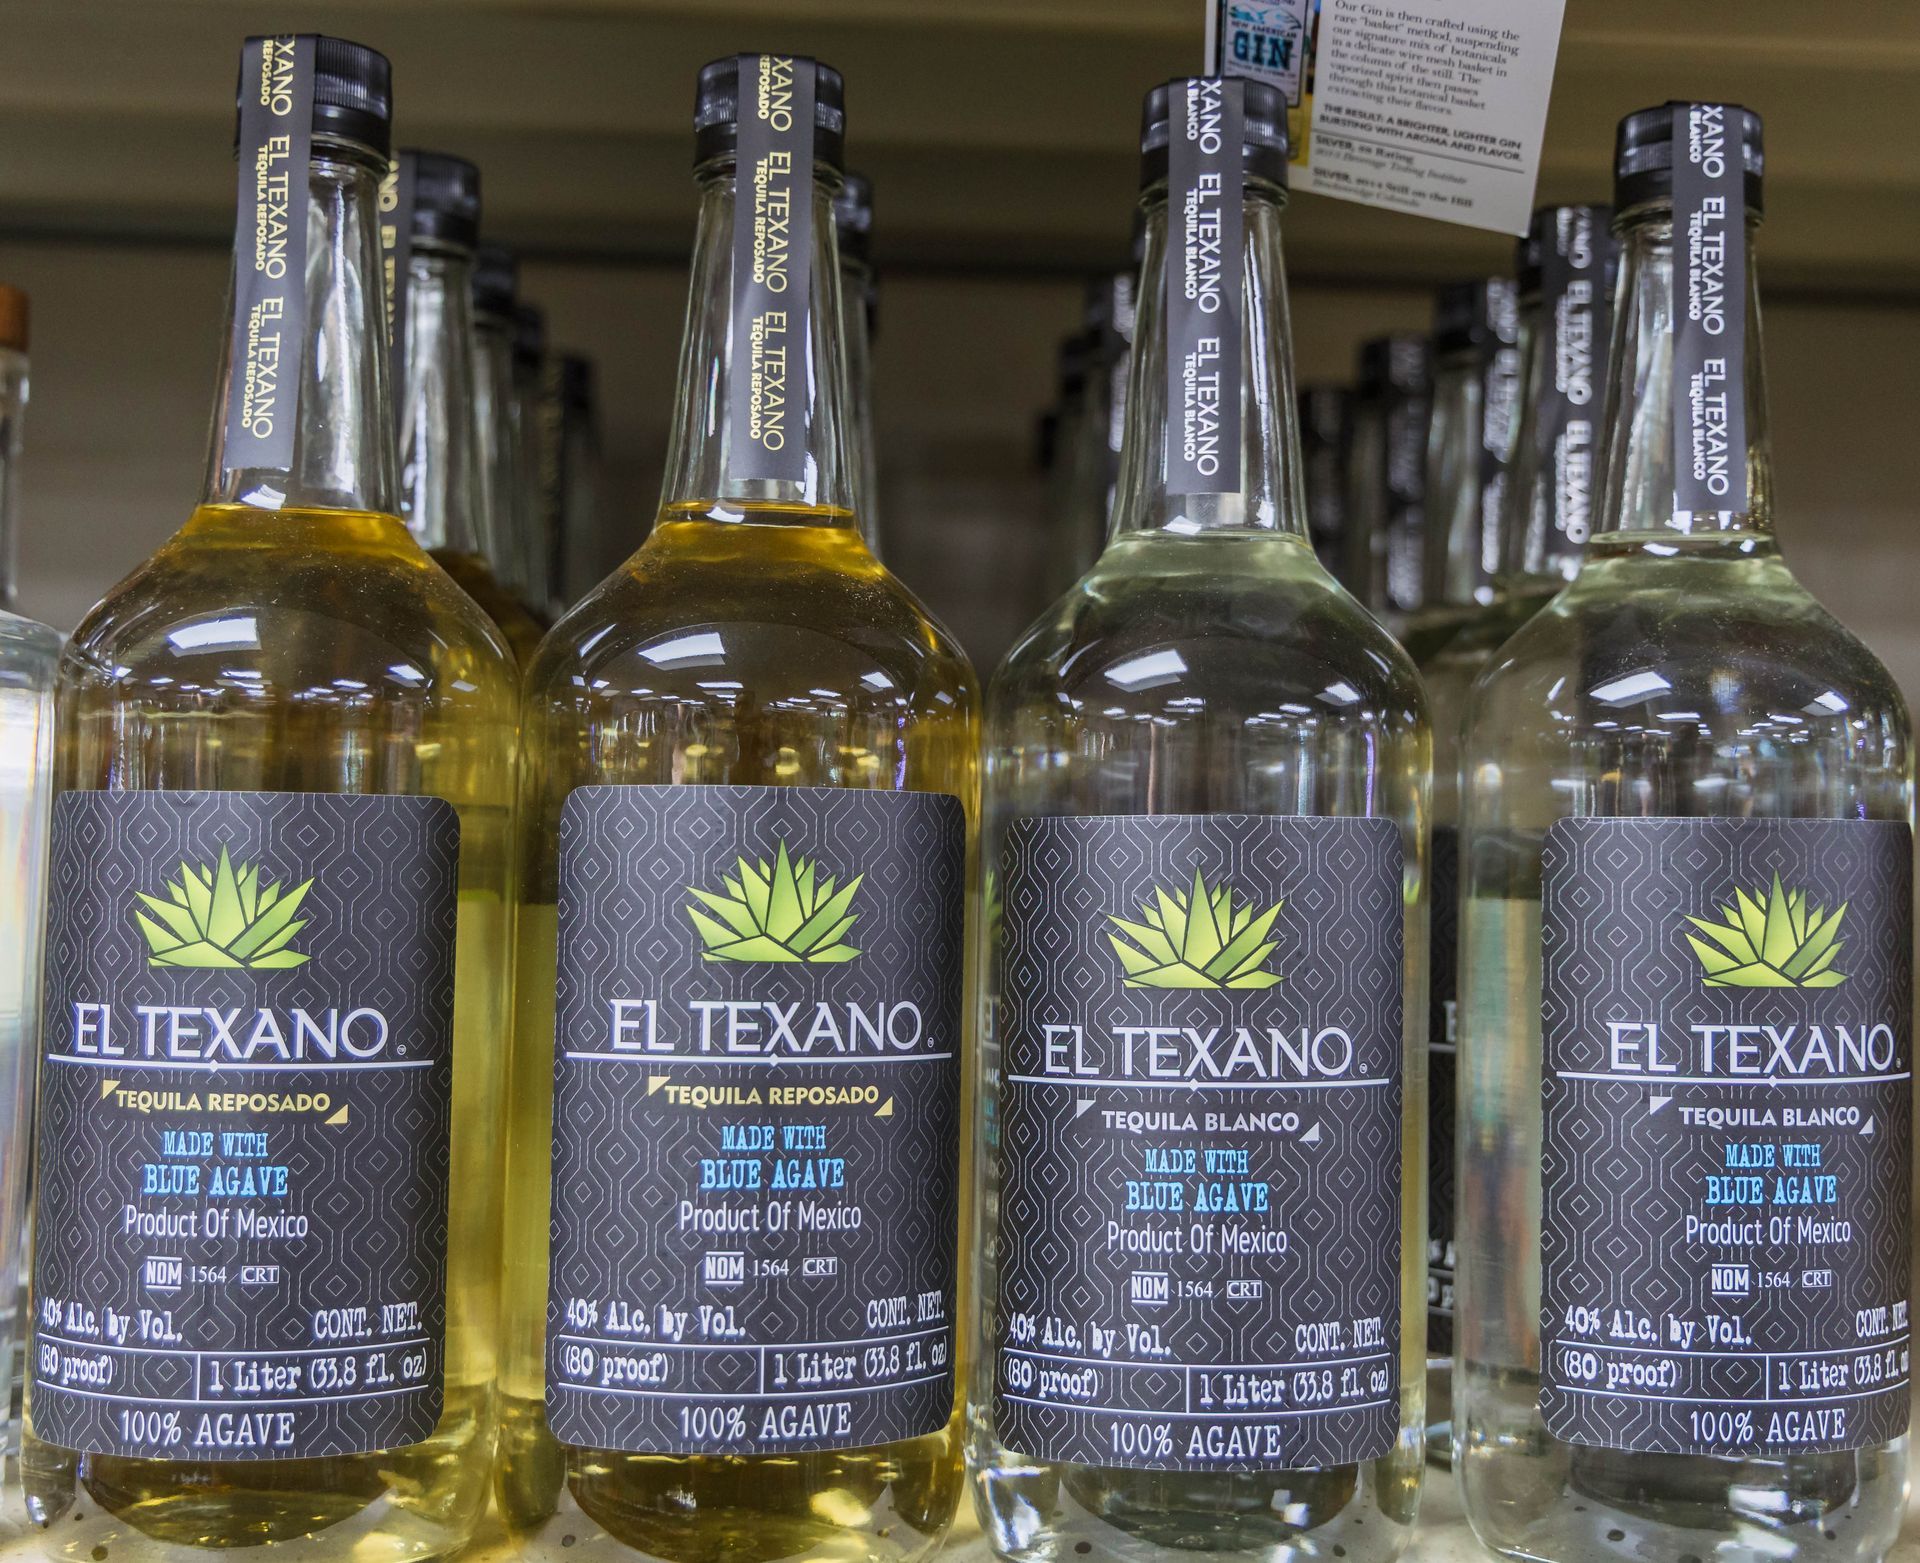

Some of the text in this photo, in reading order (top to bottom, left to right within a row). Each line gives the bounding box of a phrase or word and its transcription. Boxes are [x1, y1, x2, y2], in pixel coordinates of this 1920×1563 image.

[1334, 14, 1357, 25] rare
[1455, 35, 1519, 56] suspending
[1335, 0, 1520, 41] Our Gin is then crafted using the
[1234, 30, 1293, 70] GIN
[1332, 38, 1342, 46] in
[1354, 41, 1395, 56] delicate
[1399, 49, 1422, 60] wire
[1426, 54, 1455, 67] mesh
[1458, 59, 1492, 74] basket
[1496, 66, 1507, 77] in
[1333, 27, 1507, 64] our signature mix of botanicals
[260, 39, 273, 106] REPOSADO
[1331, 49, 1347, 60] the
[1351, 54, 1392, 67] column
[1395, 61, 1406, 70] of
[1412, 63, 1429, 74] the
[1457, 72, 1481, 84] The
[255, 145, 268, 271] TEQUILA REPOSADO
[265, 134, 290, 279] EL TEXANO
[753, 158, 768, 284] TEQUILA REPOSADO
[766, 152, 791, 293] EL TEXANO
[1184, 188, 1198, 300] TEQUILA BLANCO
[1198, 173, 1221, 314] EL TEXANO
[1688, 210, 1702, 320] TEQUILA BLANCO
[1702, 196, 1725, 335] EL TEXANO
[75, 1002, 389, 1059] EL TEXANO
[610, 999, 922, 1052] EL TEXANO
[1042, 1024, 1352, 1077] EL TEXANO
[1606, 1022, 1894, 1074] EL TEXANO
[115, 1090, 331, 1114] TEQUILA REPOSADO
[664, 1086, 880, 1109] TEQUILA REPOSADO
[1101, 1110, 1299, 1133] TEQUILA BLANCO
[1679, 1107, 1860, 1129] TEQUILA BLANCO
[163, 1132, 269, 1158] MADE WITH
[722, 1125, 827, 1151] MADE WITH
[1725, 1144, 1821, 1168] MADE WITH
[143, 1164, 288, 1196] BLUE AGAVE
[701, 1158, 845, 1189] BLUE AGAVE
[1145, 1149, 1248, 1173] MADE WITH
[1125, 1182, 1268, 1212] BLUE AGAVE
[1706, 1176, 1836, 1204] BLUE AGAVE
[680, 1201, 862, 1232] Product Of Mexico
[1107, 1221, 1287, 1254] Product Of Mexico
[706, 1256, 836, 1280] NOM 1564 CRT
[1132, 1277, 1262, 1299] NOM 1564 CRT
[567, 1298, 746, 1342] 40% Alc. by Vol.
[867, 1292, 944, 1328] CONT. NET.
[1009, 1312, 1171, 1358] 40% Alc. by Vol.
[1295, 1317, 1385, 1353] CONT. NET.
[565, 1344, 669, 1384] (80 proof)
[774, 1337, 947, 1383] 1 Liter (33.8 fl. oz)
[1007, 1359, 1099, 1398] (80 proof)
[1200, 1363, 1388, 1404] 1 Liter (33.8 fl. oz)
[681, 1403, 852, 1441] 100% AGAVE
[1111, 1422, 1282, 1458] 100% AGAVE
